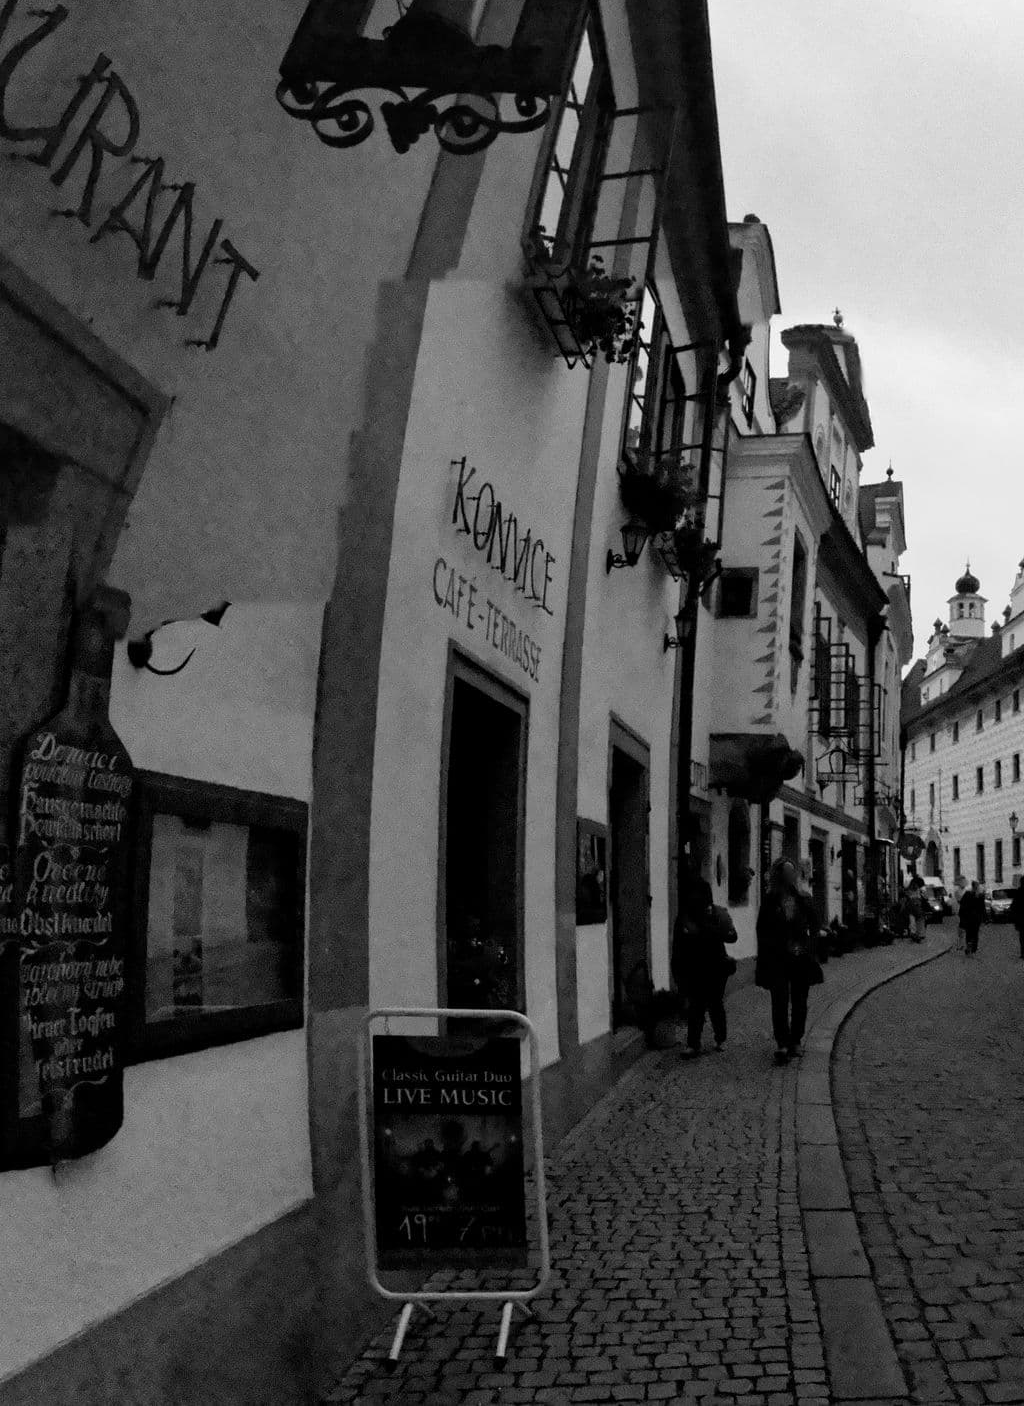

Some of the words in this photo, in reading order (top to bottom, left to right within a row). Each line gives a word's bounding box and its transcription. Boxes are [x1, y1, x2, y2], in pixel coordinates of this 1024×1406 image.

[381, 1067, 429, 1082] Classic
[434, 1067, 478, 1083] Guitar
[484, 1069, 513, 1083] Duo
[384, 1088, 432, 1105] LIVE
[440, 1089, 513, 1106] MUSIC
